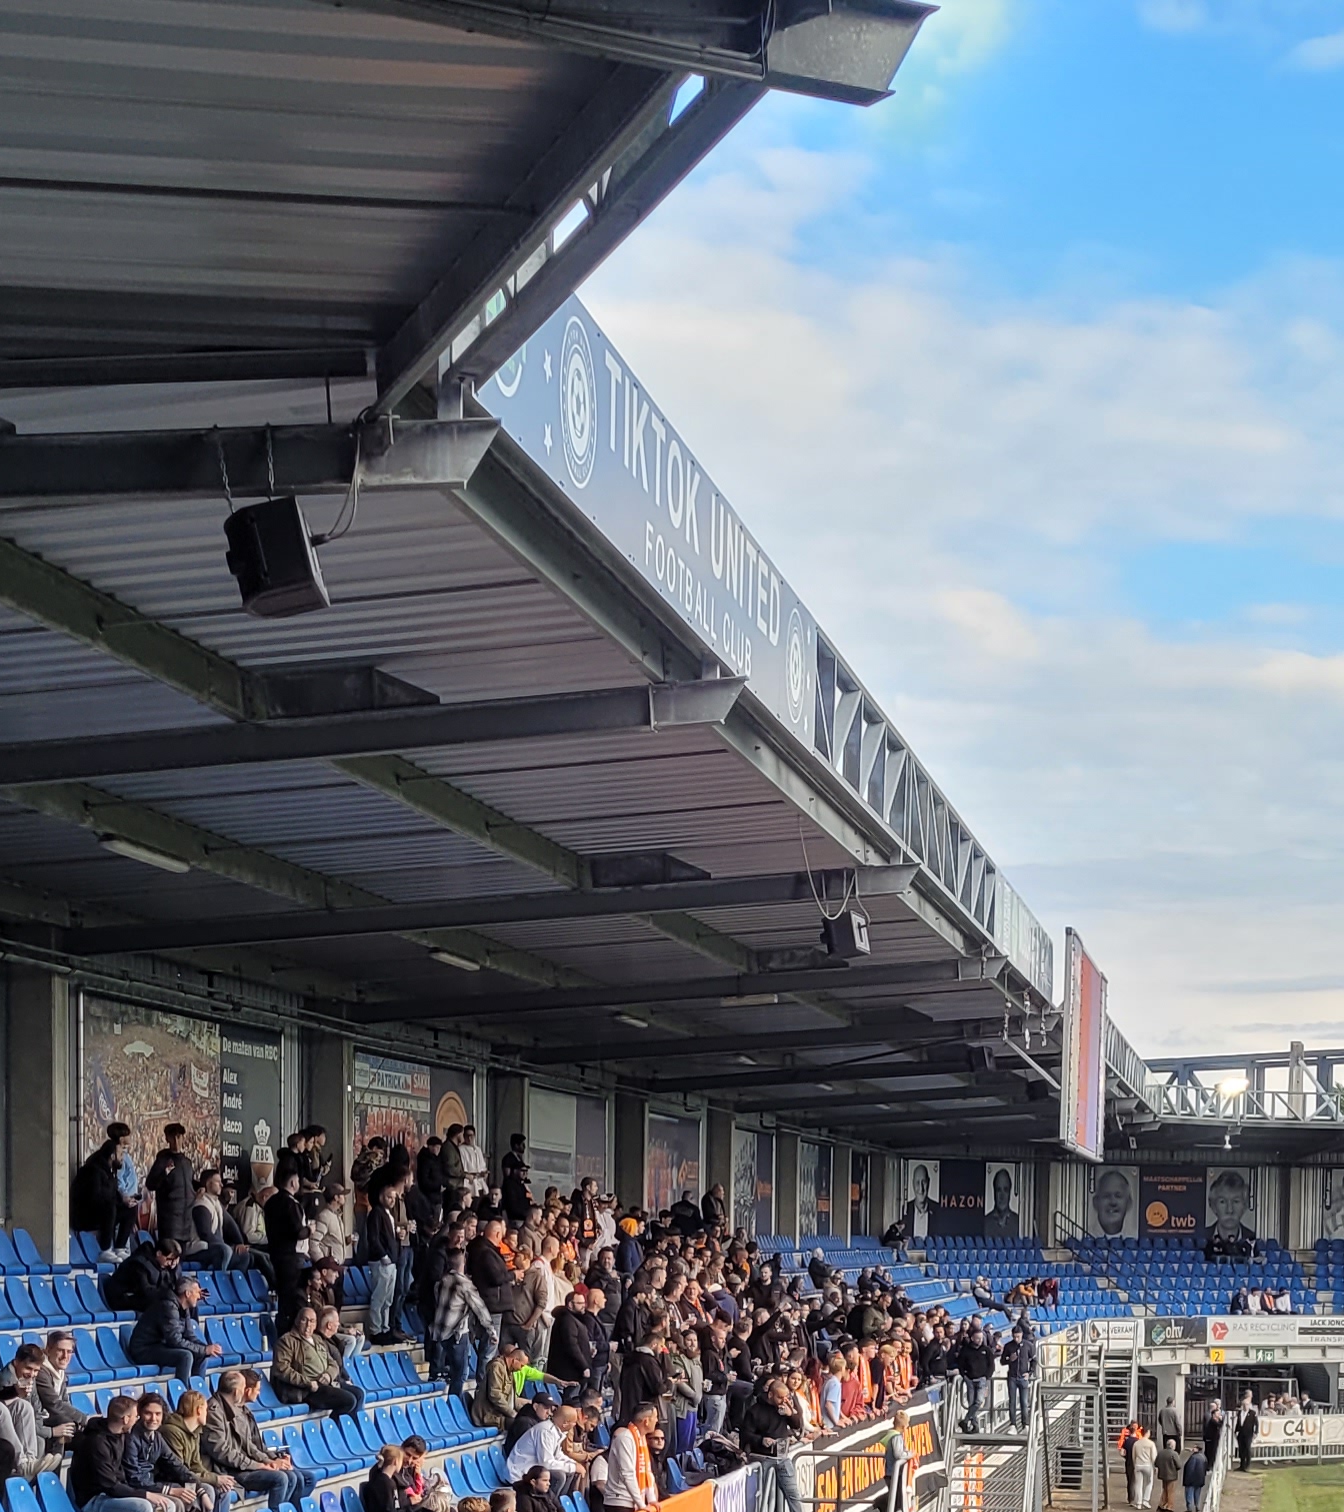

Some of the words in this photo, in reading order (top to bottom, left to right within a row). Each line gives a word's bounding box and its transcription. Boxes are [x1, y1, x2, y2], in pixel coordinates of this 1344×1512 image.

[604, 349, 702, 555] TIKTOK
[710, 493, 781, 648] UNITED
[644, 520, 718, 641] FOOTBALL
[722, 611, 753, 677] CLUB
[223, 1067, 238, 1085] Alex
[223, 1092, 243, 1110] André
[223, 1116, 243, 1134] Jacco
[223, 1140, 239, 1158] Hans
[940, 1195, 984, 1208] HAZON
[1171, 1213, 1196, 1228] twb
[1250, 1322, 1296, 1332] RECYCLING
[1310, 1319, 1327, 1327] JACK
[1213, 1351, 1221, 1362] 2
[1283, 1419, 1317, 1437] C4U
